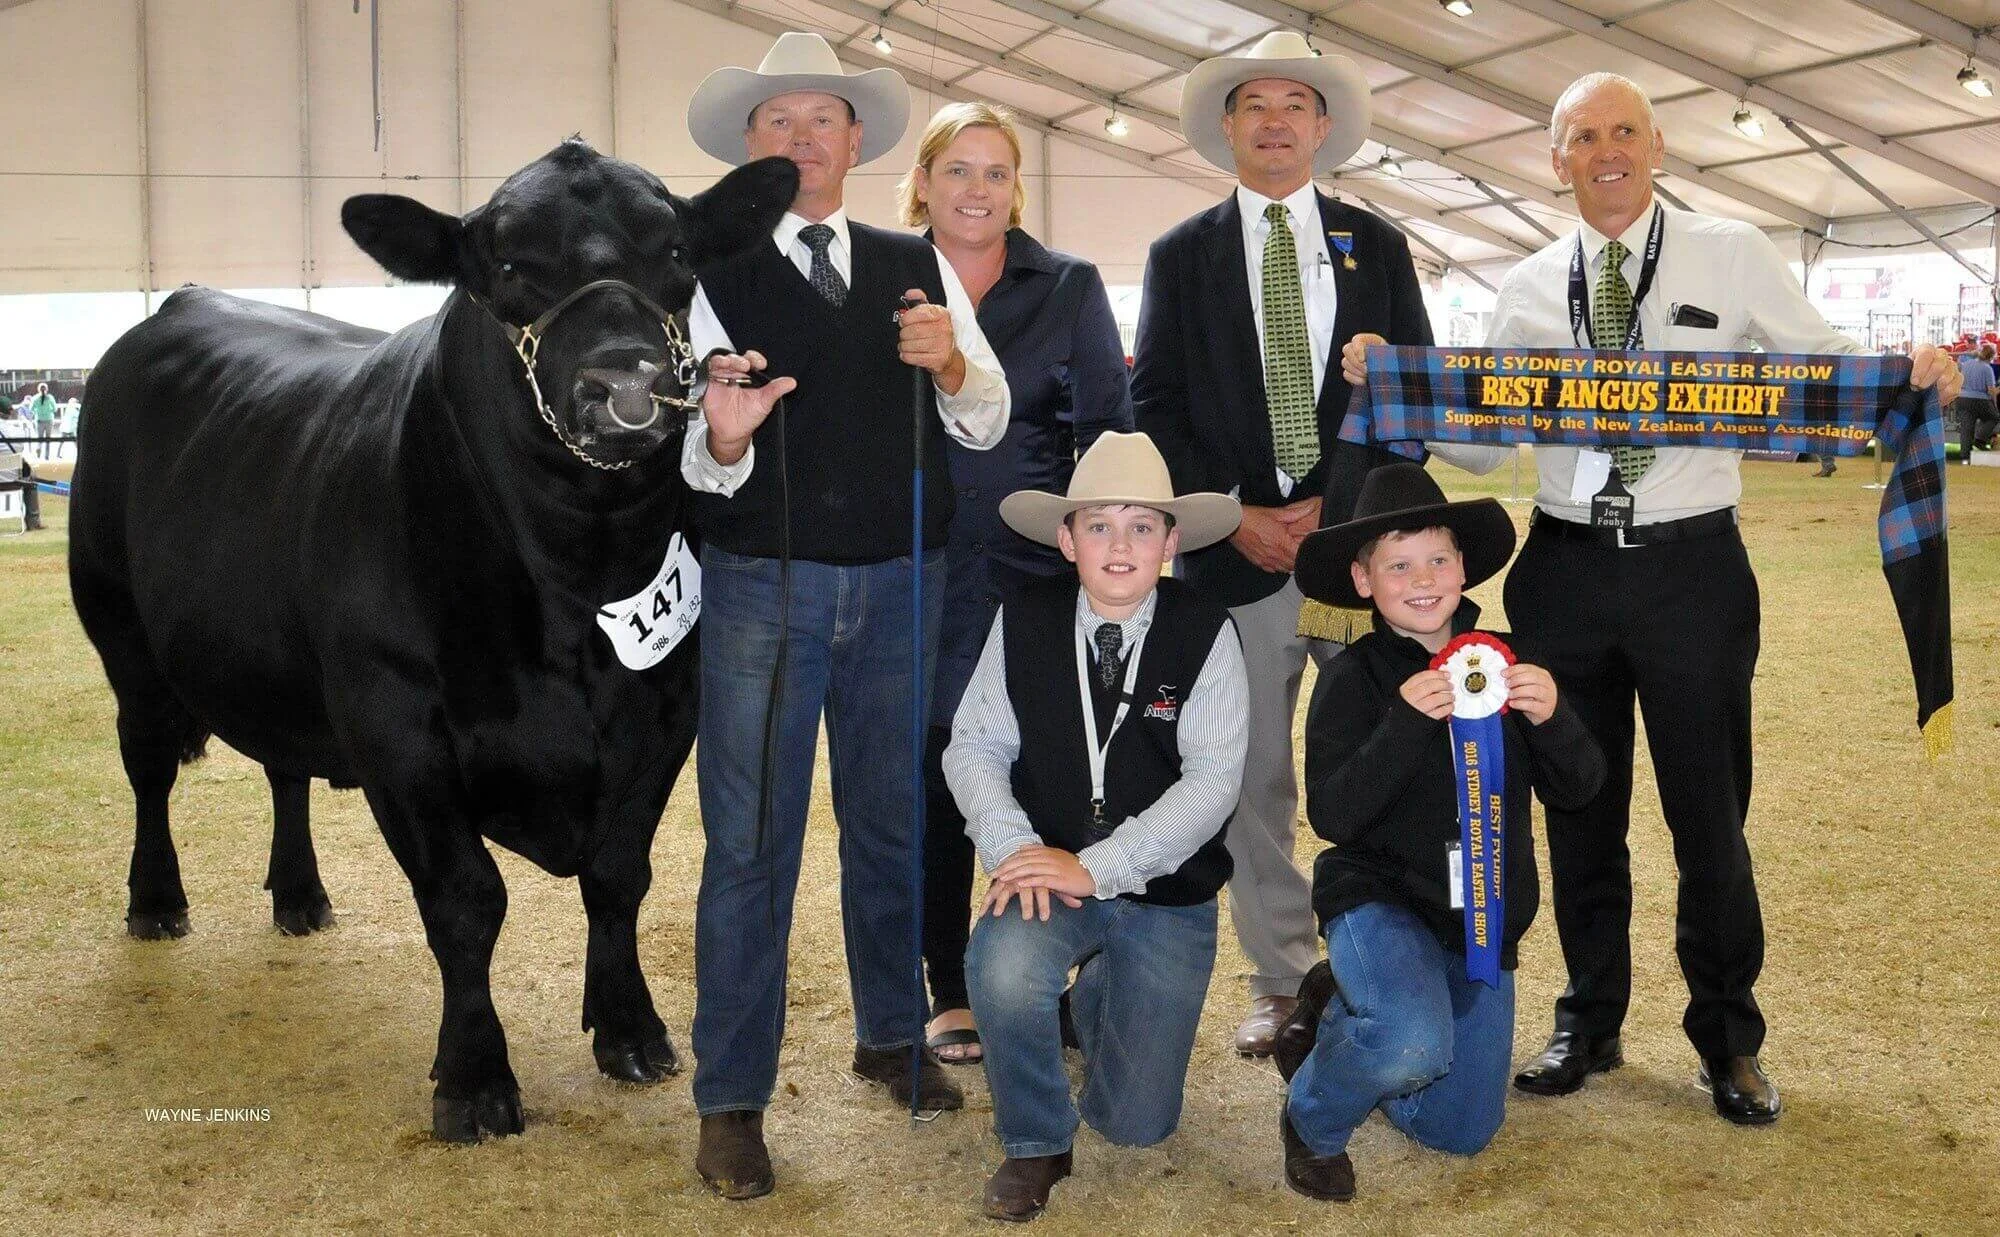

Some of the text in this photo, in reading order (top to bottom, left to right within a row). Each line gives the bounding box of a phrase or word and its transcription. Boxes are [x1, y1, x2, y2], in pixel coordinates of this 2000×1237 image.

[1444, 355, 1833, 380] 2016 SYDNEY ROYAL EASTER SHOW
[1481, 375, 1785, 417] BEST ANGUS EXHIBIT
[1444, 410, 1874, 440] Supported by the New Zealand Angus Association
[1603, 508, 1620, 517] Joe
[629, 566, 683, 643] 147
[652, 635, 670, 651] 986
[1490, 794, 1501, 834] BEST
[1463, 741, 1487, 948] 2016 SYDNEY ROYAL EASTER SHOW
